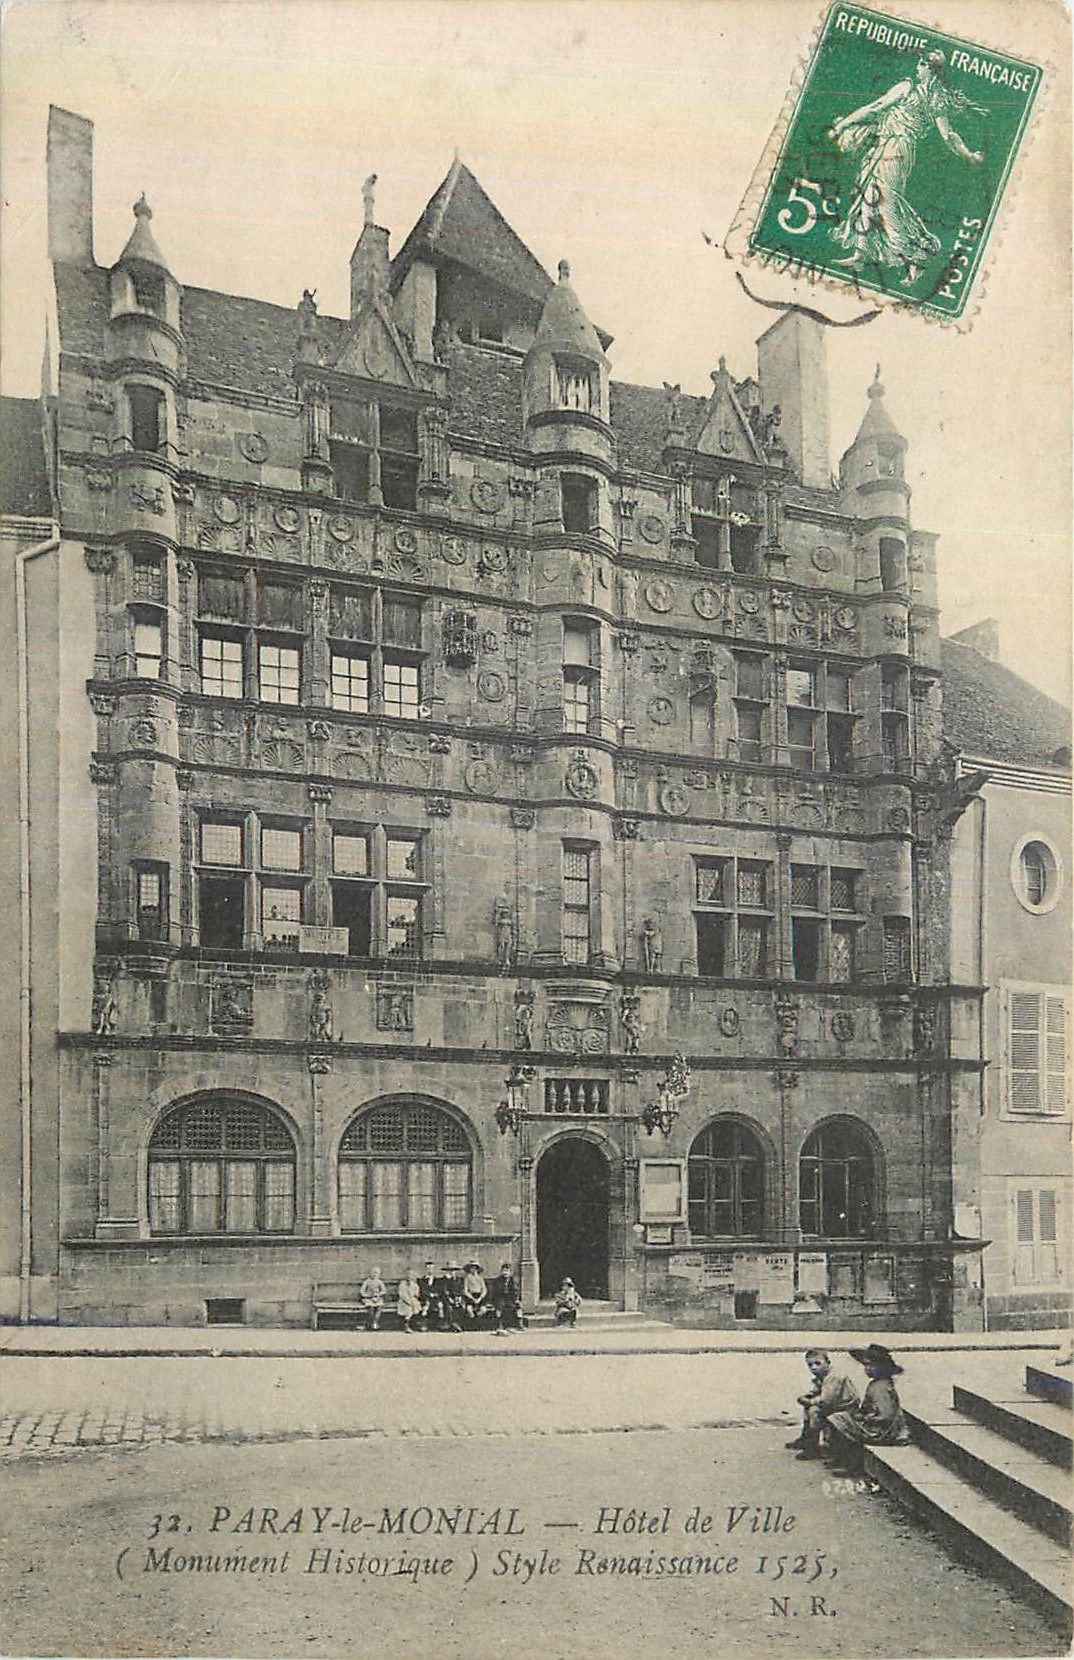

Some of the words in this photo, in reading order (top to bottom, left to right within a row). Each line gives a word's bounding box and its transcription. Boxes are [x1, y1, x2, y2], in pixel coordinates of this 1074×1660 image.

[835, 12, 928, 50] REPUBLIQUE
[949, 50, 1032, 92] FRANÇAISE
[939, 217, 982, 299] POSTES
